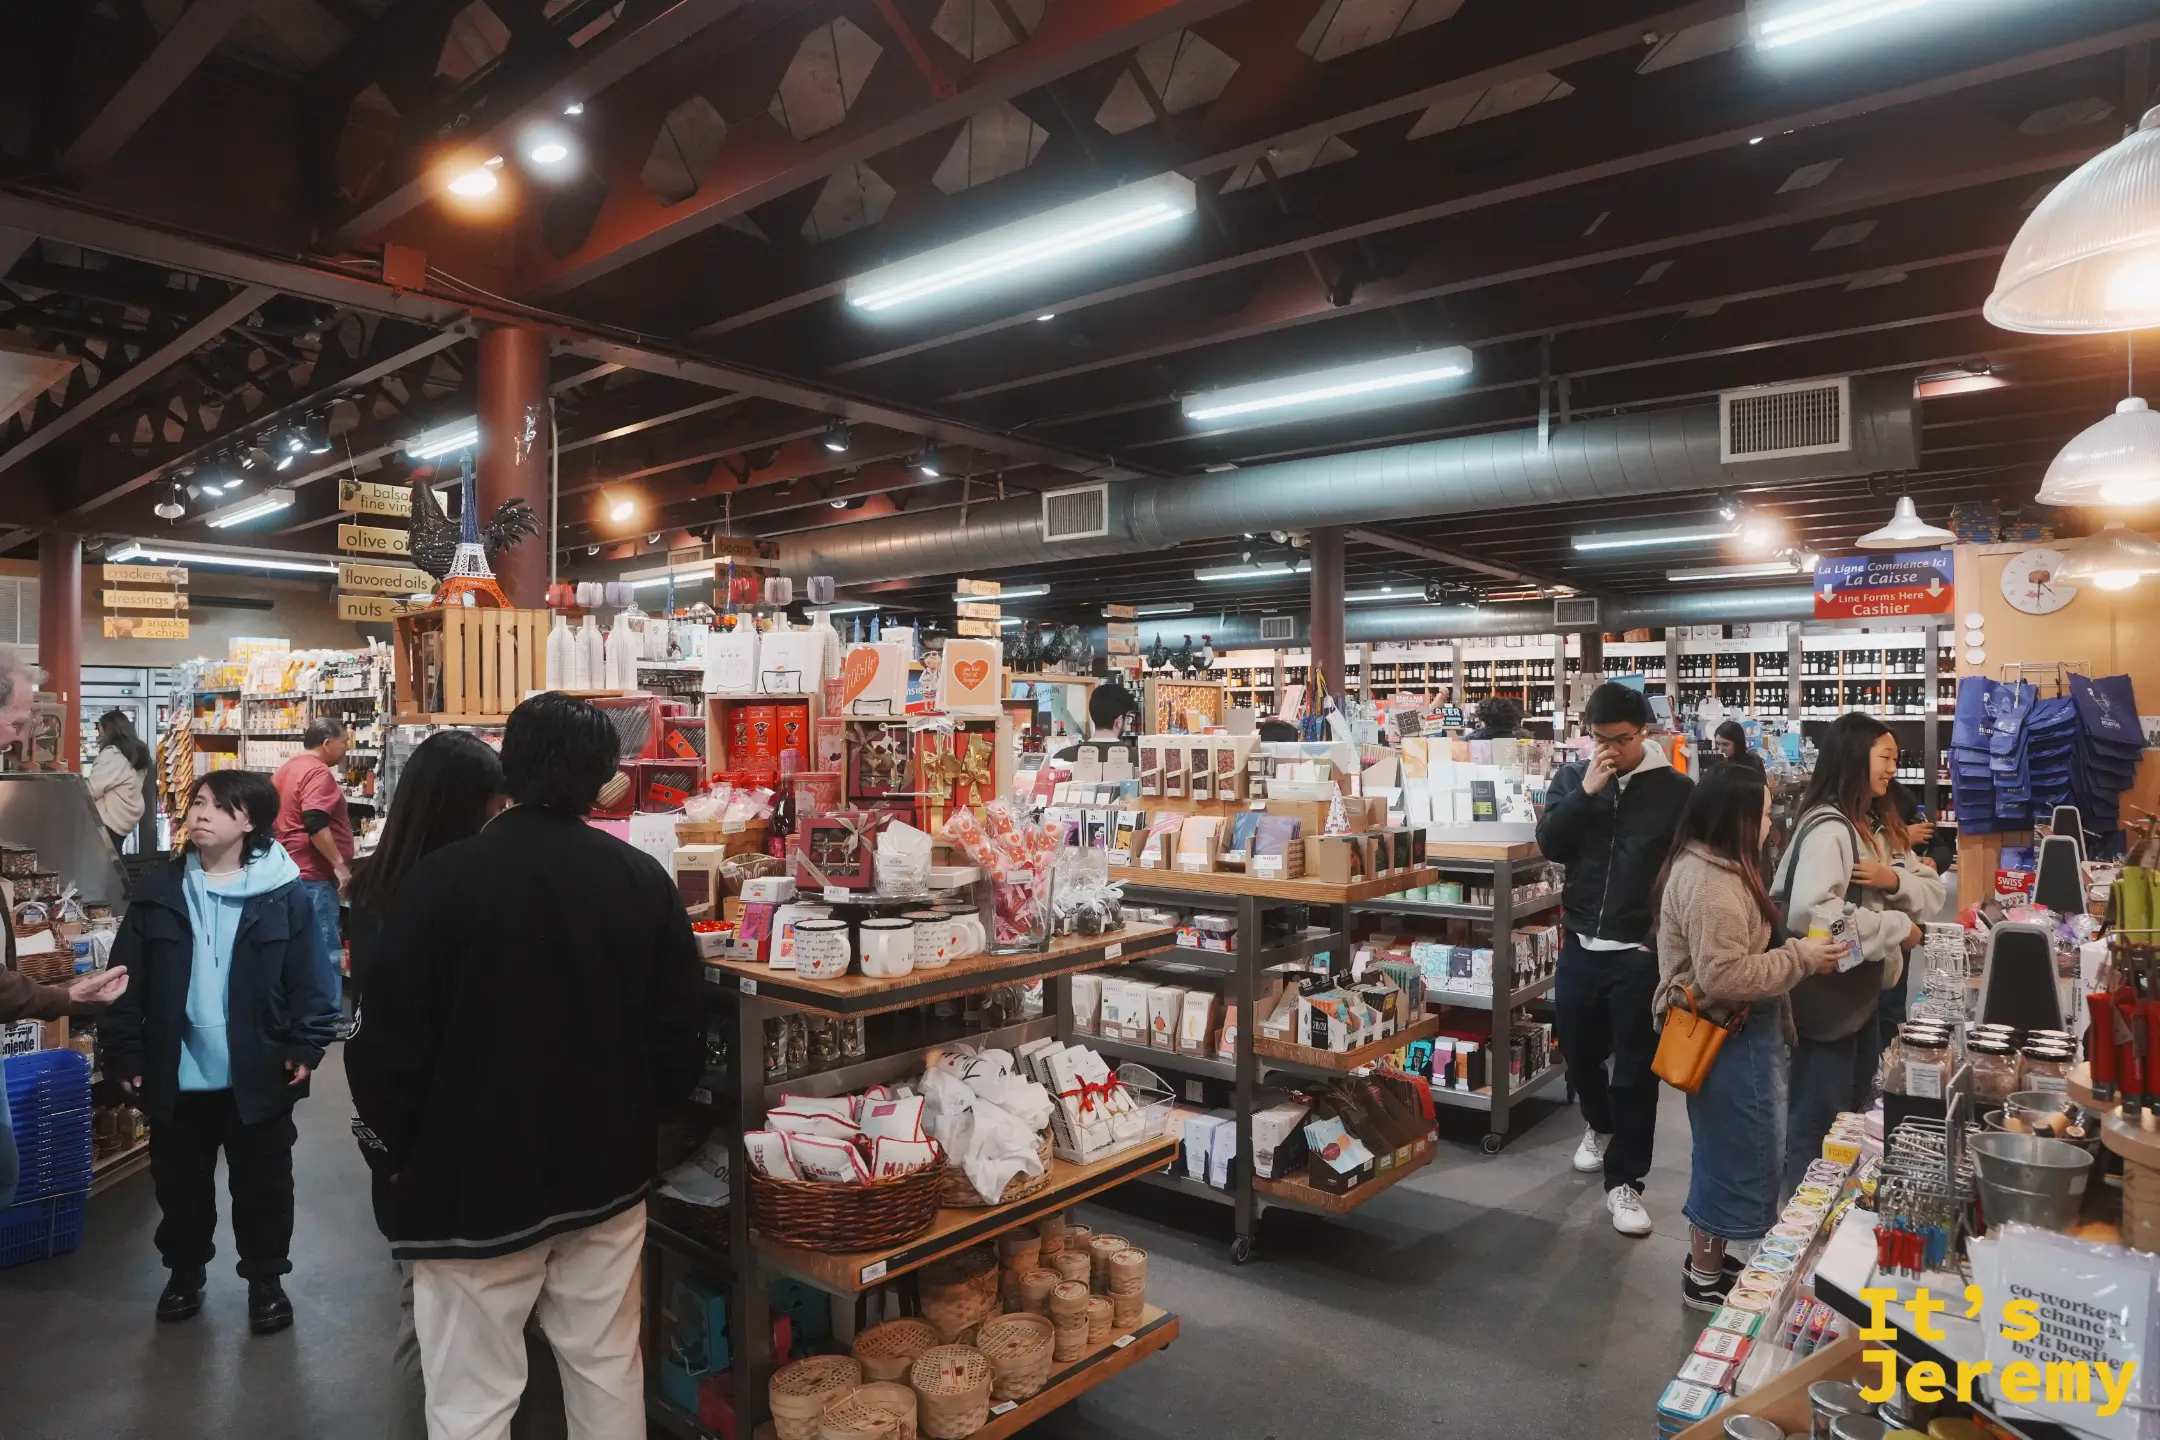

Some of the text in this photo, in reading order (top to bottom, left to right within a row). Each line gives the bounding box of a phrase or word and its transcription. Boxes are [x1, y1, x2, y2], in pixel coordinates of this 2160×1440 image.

[361, 495, 385, 510] fine
[346, 530, 387, 549] olive
[720, 541, 752, 555] beans
[1818, 557, 1947, 575] La Ligne Commence Ici
[107, 568, 162, 580] crackers
[345, 569, 428, 590] flavored oils
[1845, 572, 1918, 587] La Caisse
[977, 584, 999, 594] honey
[108, 594, 169, 608] dressings
[1839, 591, 1924, 603] Line Forms Here
[348, 602, 382, 617] nuts
[971, 606, 1000, 617] mustards
[1852, 603, 1910, 616] Cashier
[147, 619, 185, 628] snacks
[155, 627, 185, 638] chips
[1998, 876, 2023, 888] SWISS
[2012, 1340, 2036, 1360] by
